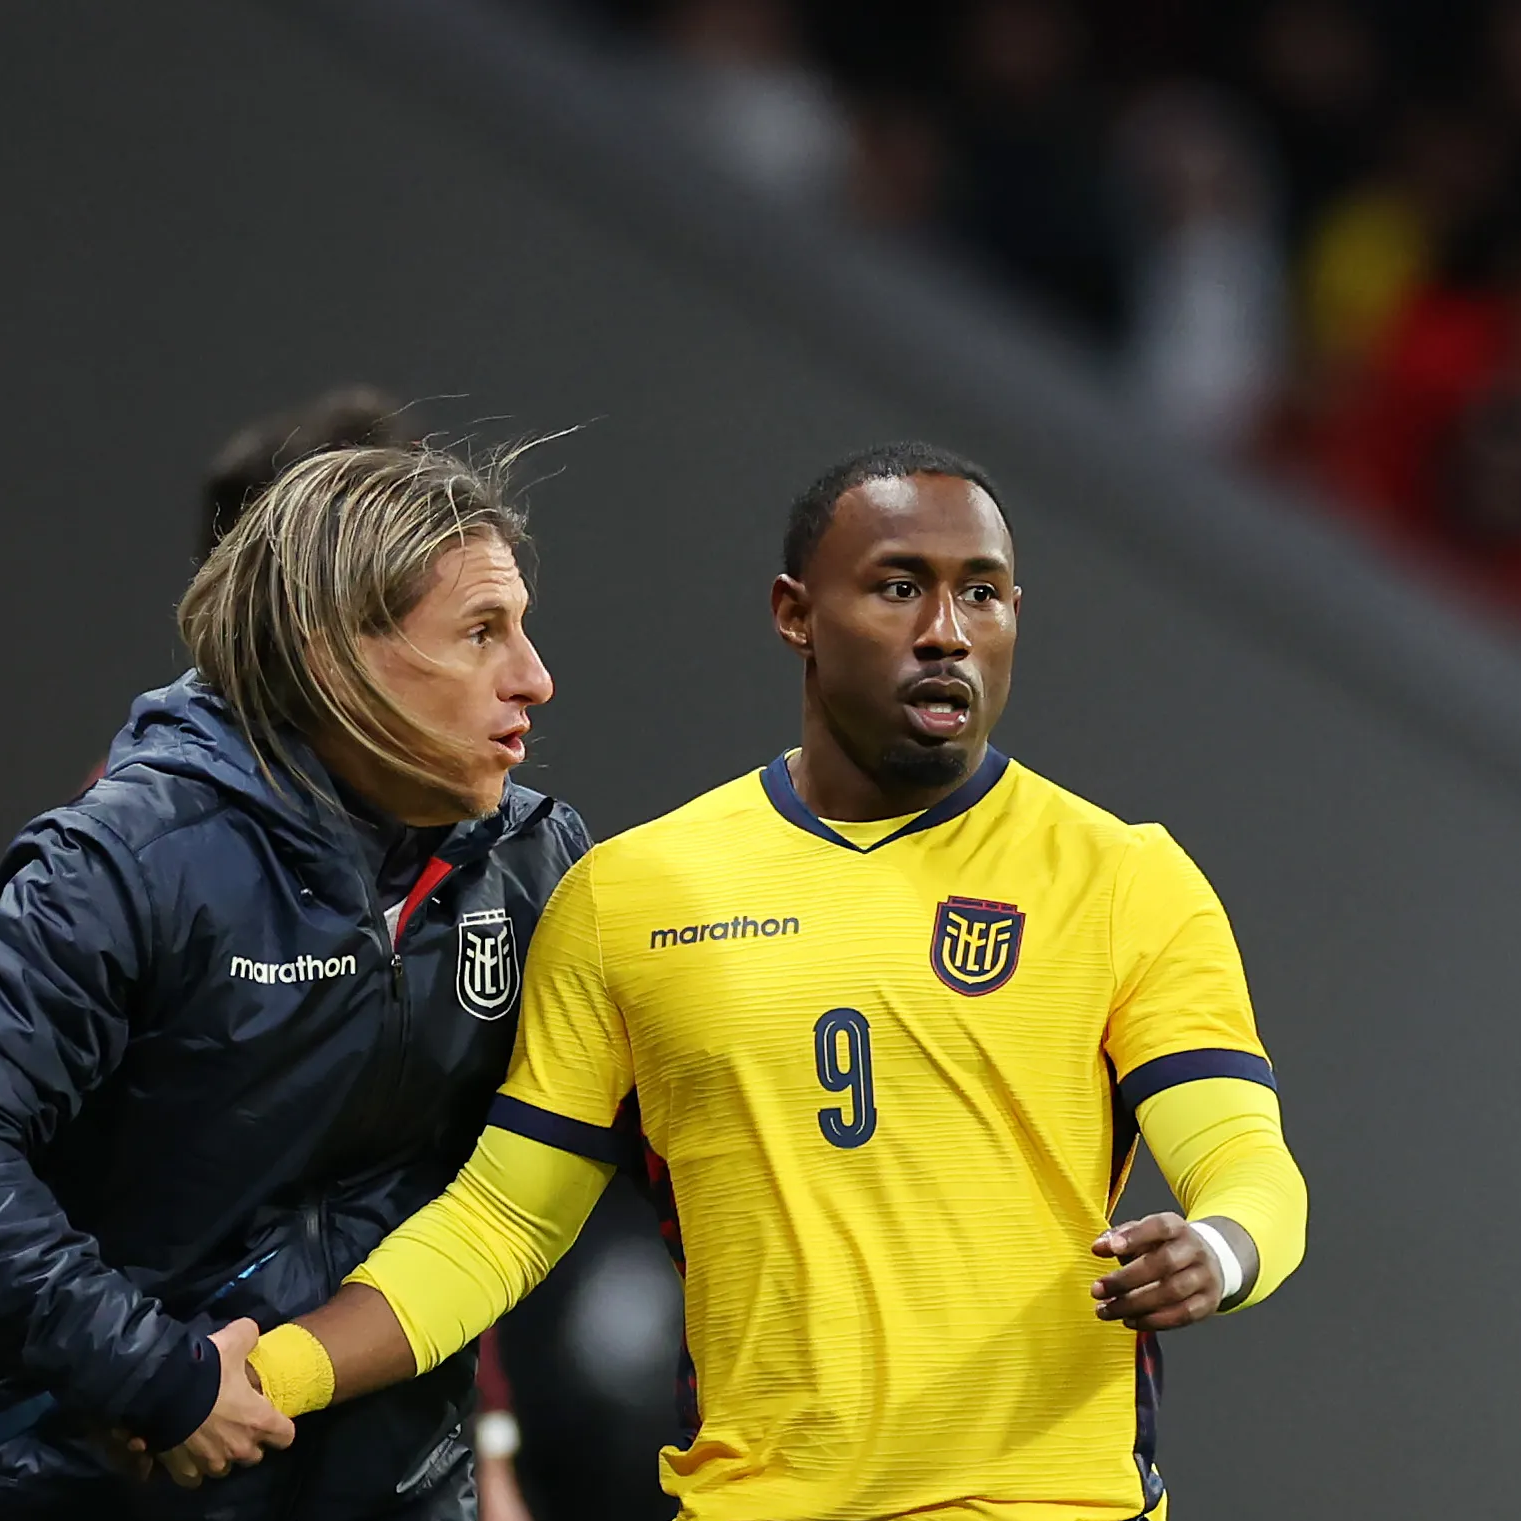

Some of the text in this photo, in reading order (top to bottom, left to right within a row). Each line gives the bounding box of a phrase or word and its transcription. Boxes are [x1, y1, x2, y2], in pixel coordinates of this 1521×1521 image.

[650, 915, 800, 949] marathon
[230, 953, 356, 985] marathon
[813, 1007, 877, 1149] 9
